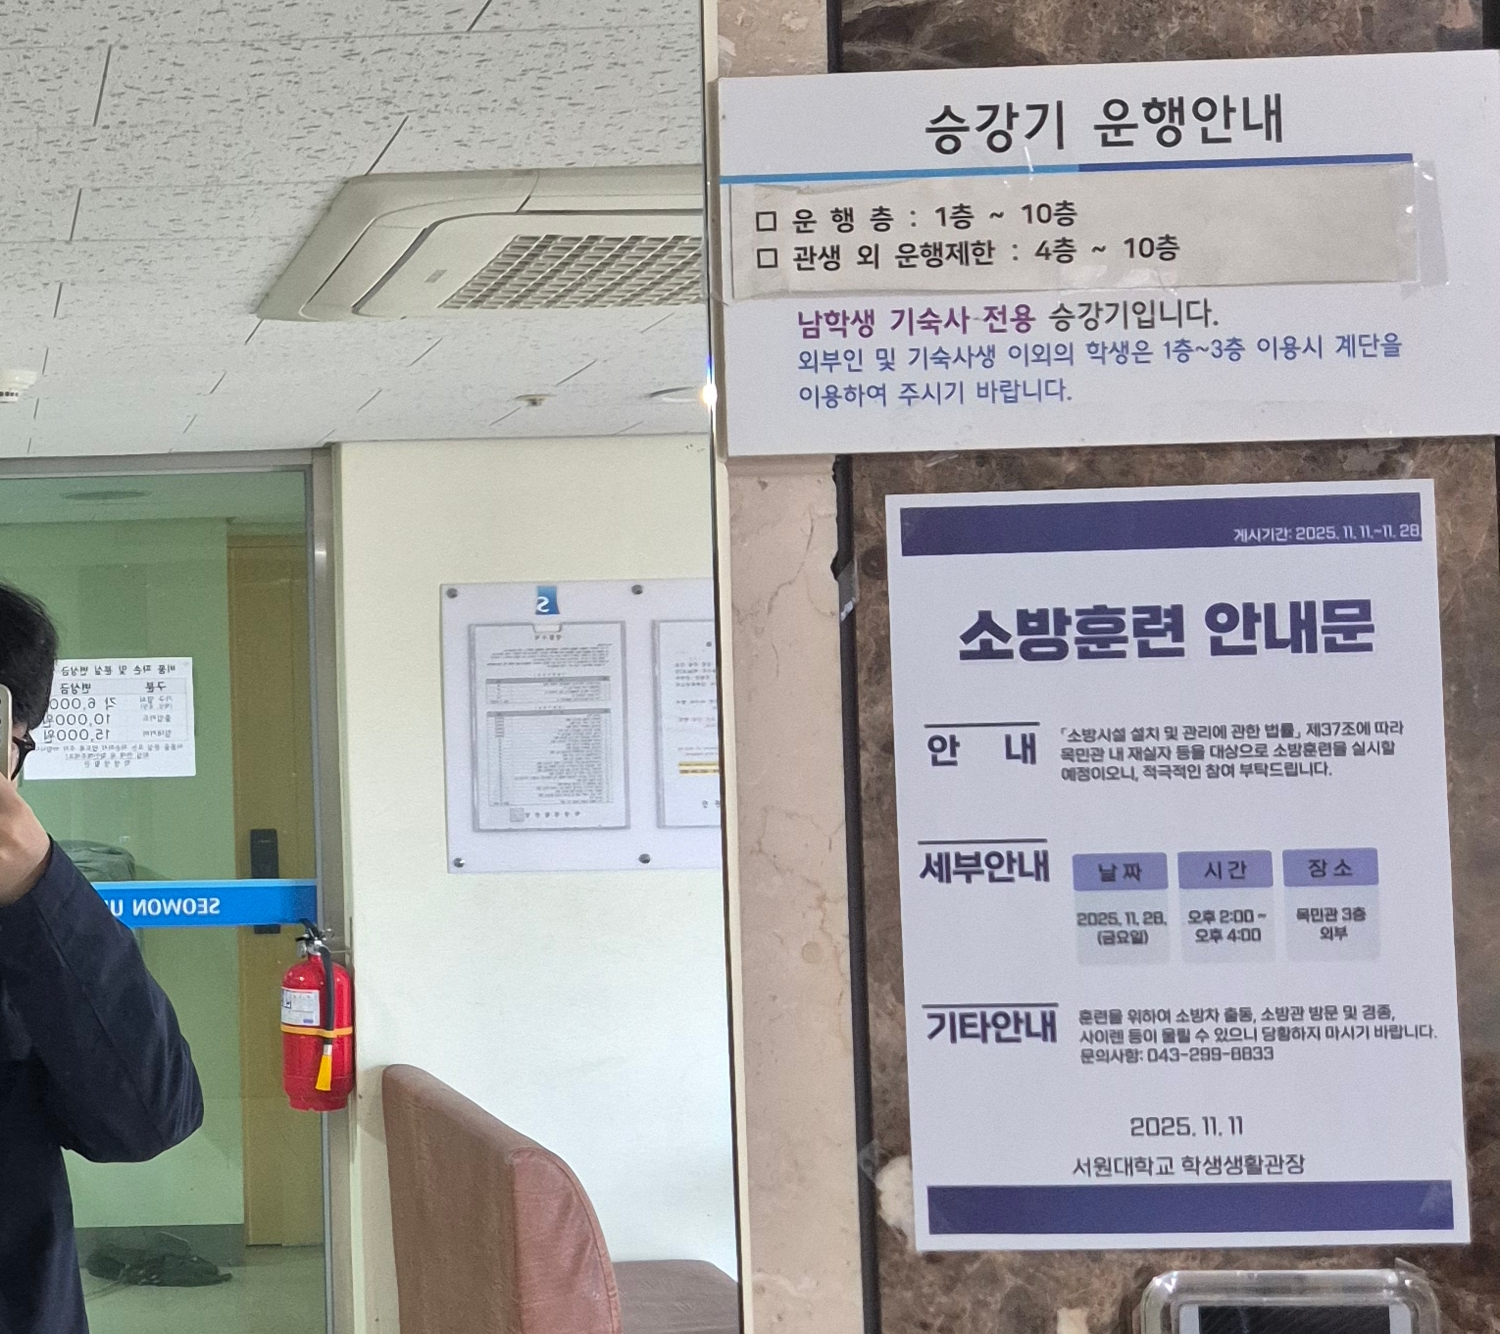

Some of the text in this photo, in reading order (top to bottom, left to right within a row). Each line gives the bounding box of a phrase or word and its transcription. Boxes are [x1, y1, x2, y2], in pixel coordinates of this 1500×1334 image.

[925, 93, 1283, 155] 승강기 운행안내
[934, 202, 975, 230] 1층
[1021, 199, 1078, 227] 10층
[792, 233, 1181, 272] 관생 외 운행제한 4층 10층
[797, 296, 1220, 340] 남학생 기숙사 전용 승강기입니다.
[797, 332, 1403, 374] 외부인 및 기숙사생 이외의 학생은 1층~3층 이용시 계단을
[799, 377, 1072, 410] 이용하여 주시기 바랍니다.
[1234, 525, 1339, 543] 게시기간: 2025.
[959, 599, 1375, 662] 소방훈련 안내문
[1129, 726, 1160, 743] 설치
[1163, 725, 1179, 742] 및
[1182, 724, 1228, 741] 관리에
[1230, 723, 1261, 740] 관한
[1305, 720, 1372, 738] 제37조에
[1374, 720, 1405, 736] 따라
[1060, 739, 1396, 763] 목민관 내 재실자 등을 대상으로 소방훈련을 실시할
[1061, 760, 1333, 783] 예정이오니, 적극적인 참여 부탁드립니다.
[919, 849, 1050, 884] 세부안내
[1076, 911, 1123, 927] 2025.
[1187, 908, 1255, 926] 오후 2:00
[1341, 906, 1367, 923] 3층
[1097, 929, 1149, 946] (금요일)
[1194, 927, 1262, 944] 오후 4:00
[1319, 925, 1349, 942] 외부
[925, 1008, 1060, 1045] 기타안내
[1078, 1008, 1124, 1026] 훈련을
[1127, 1008, 1172, 1025] 위하여
[1175, 1007, 1221, 1024] 소방차
[1260, 1005, 1306, 1022] 소방관
[1308, 1004, 1339, 1022] 방문
[1342, 1004, 1358, 1021] 및
[1079, 1028, 1125, 1045] 사이렌
[1127, 1028, 1158, 1045] 등이
[1194, 1027, 1210, 1044] 수
[1213, 1026, 1258, 1044] 있으니
[1261, 1025, 1321, 1043] 당황하지
[1325, 1025, 1370, 1041] 마시기
[1373, 1024, 1438, 1040] 바랍니다.
[1080, 1047, 1144, 1065] 문의사항:
[1130, 1116, 1197, 1137] 2025.
[1072, 1153, 1306, 1178] 서원대학교 학생생활관장
